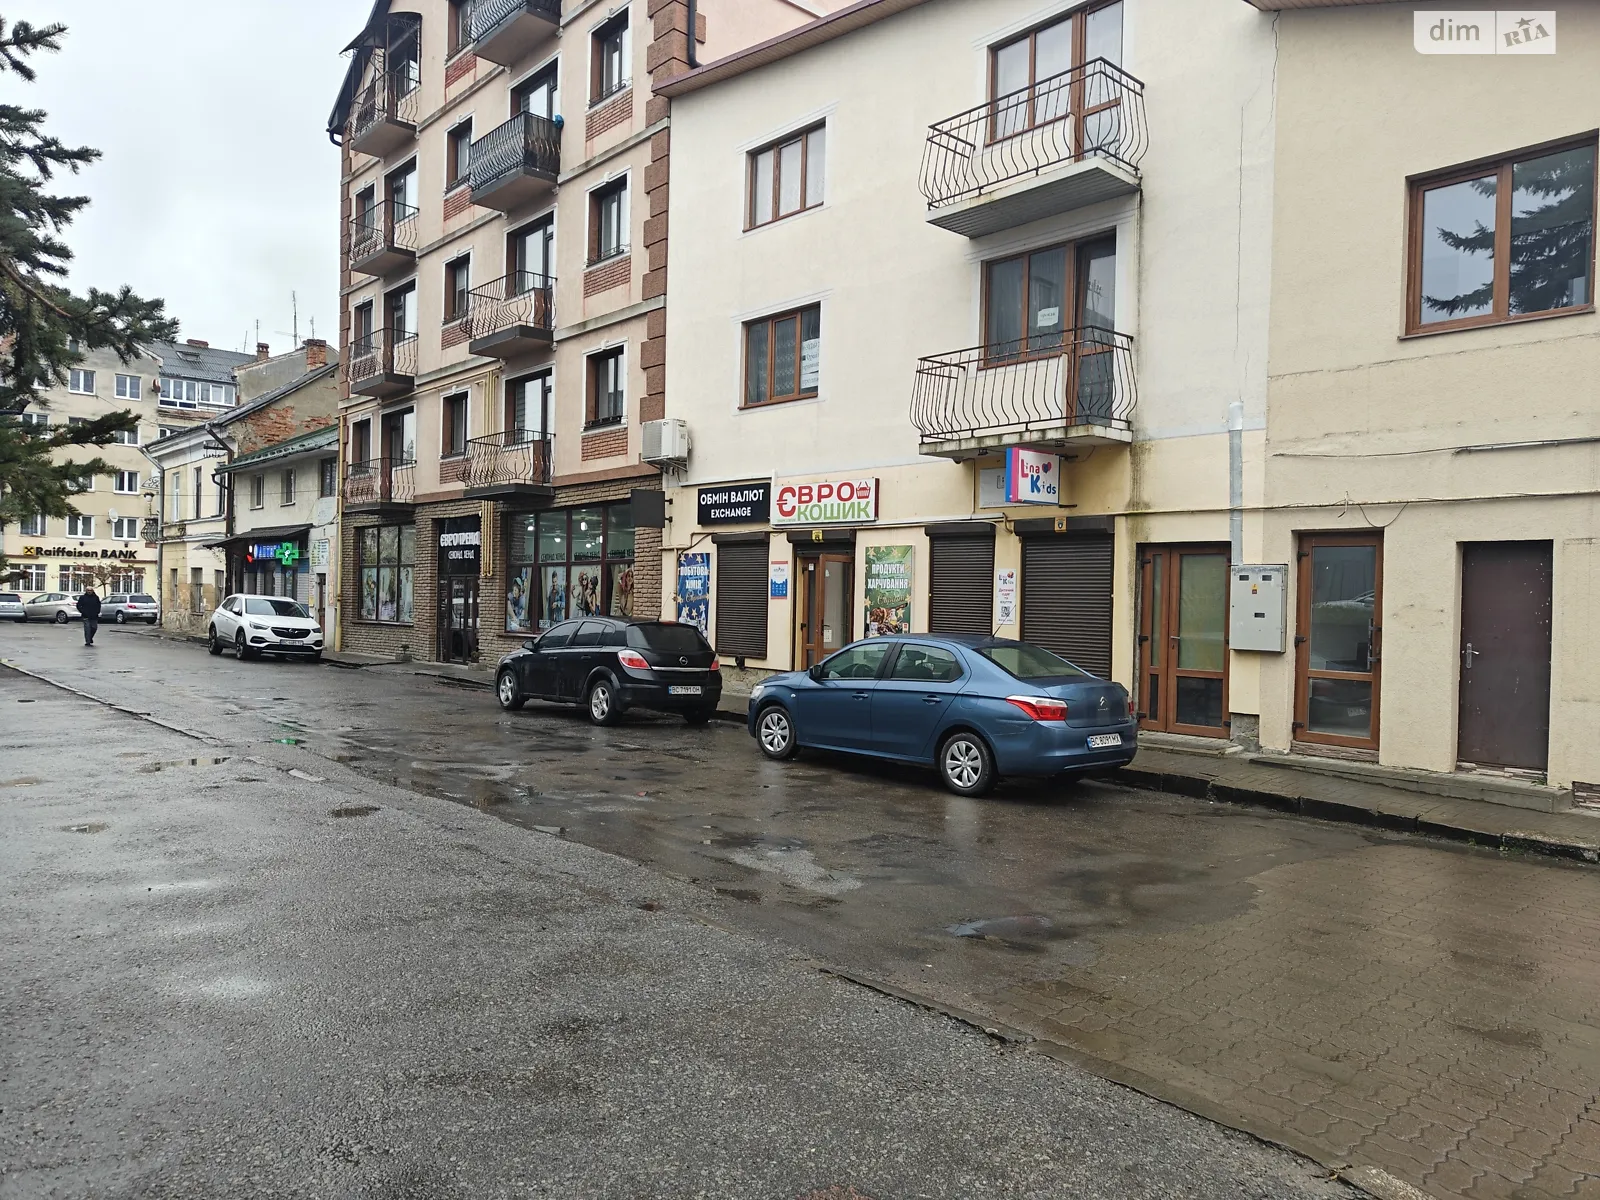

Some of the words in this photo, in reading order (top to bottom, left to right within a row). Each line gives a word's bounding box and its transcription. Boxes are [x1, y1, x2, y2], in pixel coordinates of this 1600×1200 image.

[1020, 459, 1040, 478] Lina
[1030, 474, 1057, 495] Kids
[700, 491, 729, 505] ОБМІН
[730, 488, 764, 503] ВАЛЮТ
[710, 506, 752, 519] EXCHANGE
[797, 500, 871, 522] КОШИК
[35, 546, 99, 558] Raiffeisen
[100, 549, 138, 560] BANK
[680, 566, 708, 576] ПОБУТОВА
[871, 563, 905, 575] ПРОДУКТИ
[867, 578, 909, 589] ХАРЧУВАННЯ
[1091, 737, 1099, 746] BC
[1100, 735, 1111, 745] 8091
[1111, 734, 1120, 744] MX
